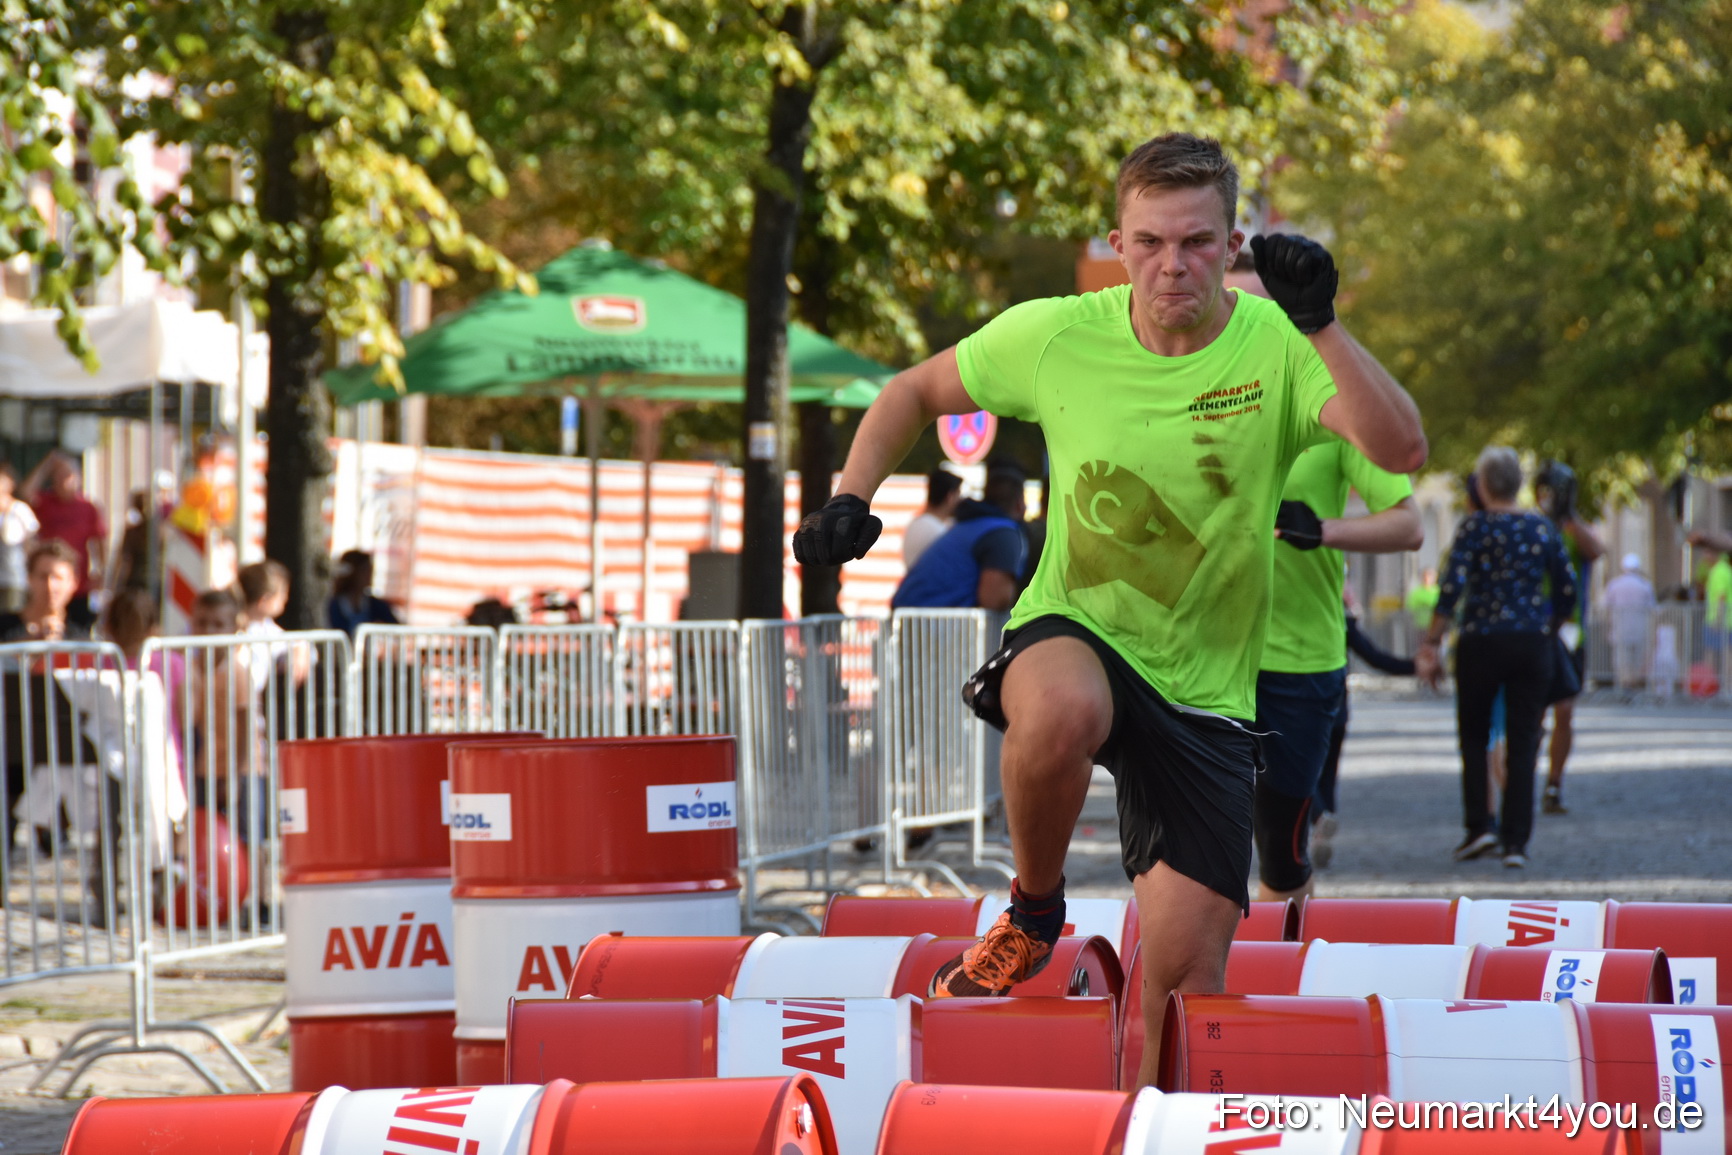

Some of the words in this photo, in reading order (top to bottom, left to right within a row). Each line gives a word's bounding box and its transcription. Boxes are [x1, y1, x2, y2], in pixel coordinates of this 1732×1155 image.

[1188, 389, 1264, 412] ELEMENTELAUF
[1192, 379, 1261, 403] NEUMARKTER
[1203, 409, 1243, 422] September
[1244, 403, 1261, 414] 2019
[1206, 1021, 1221, 1040] 362
